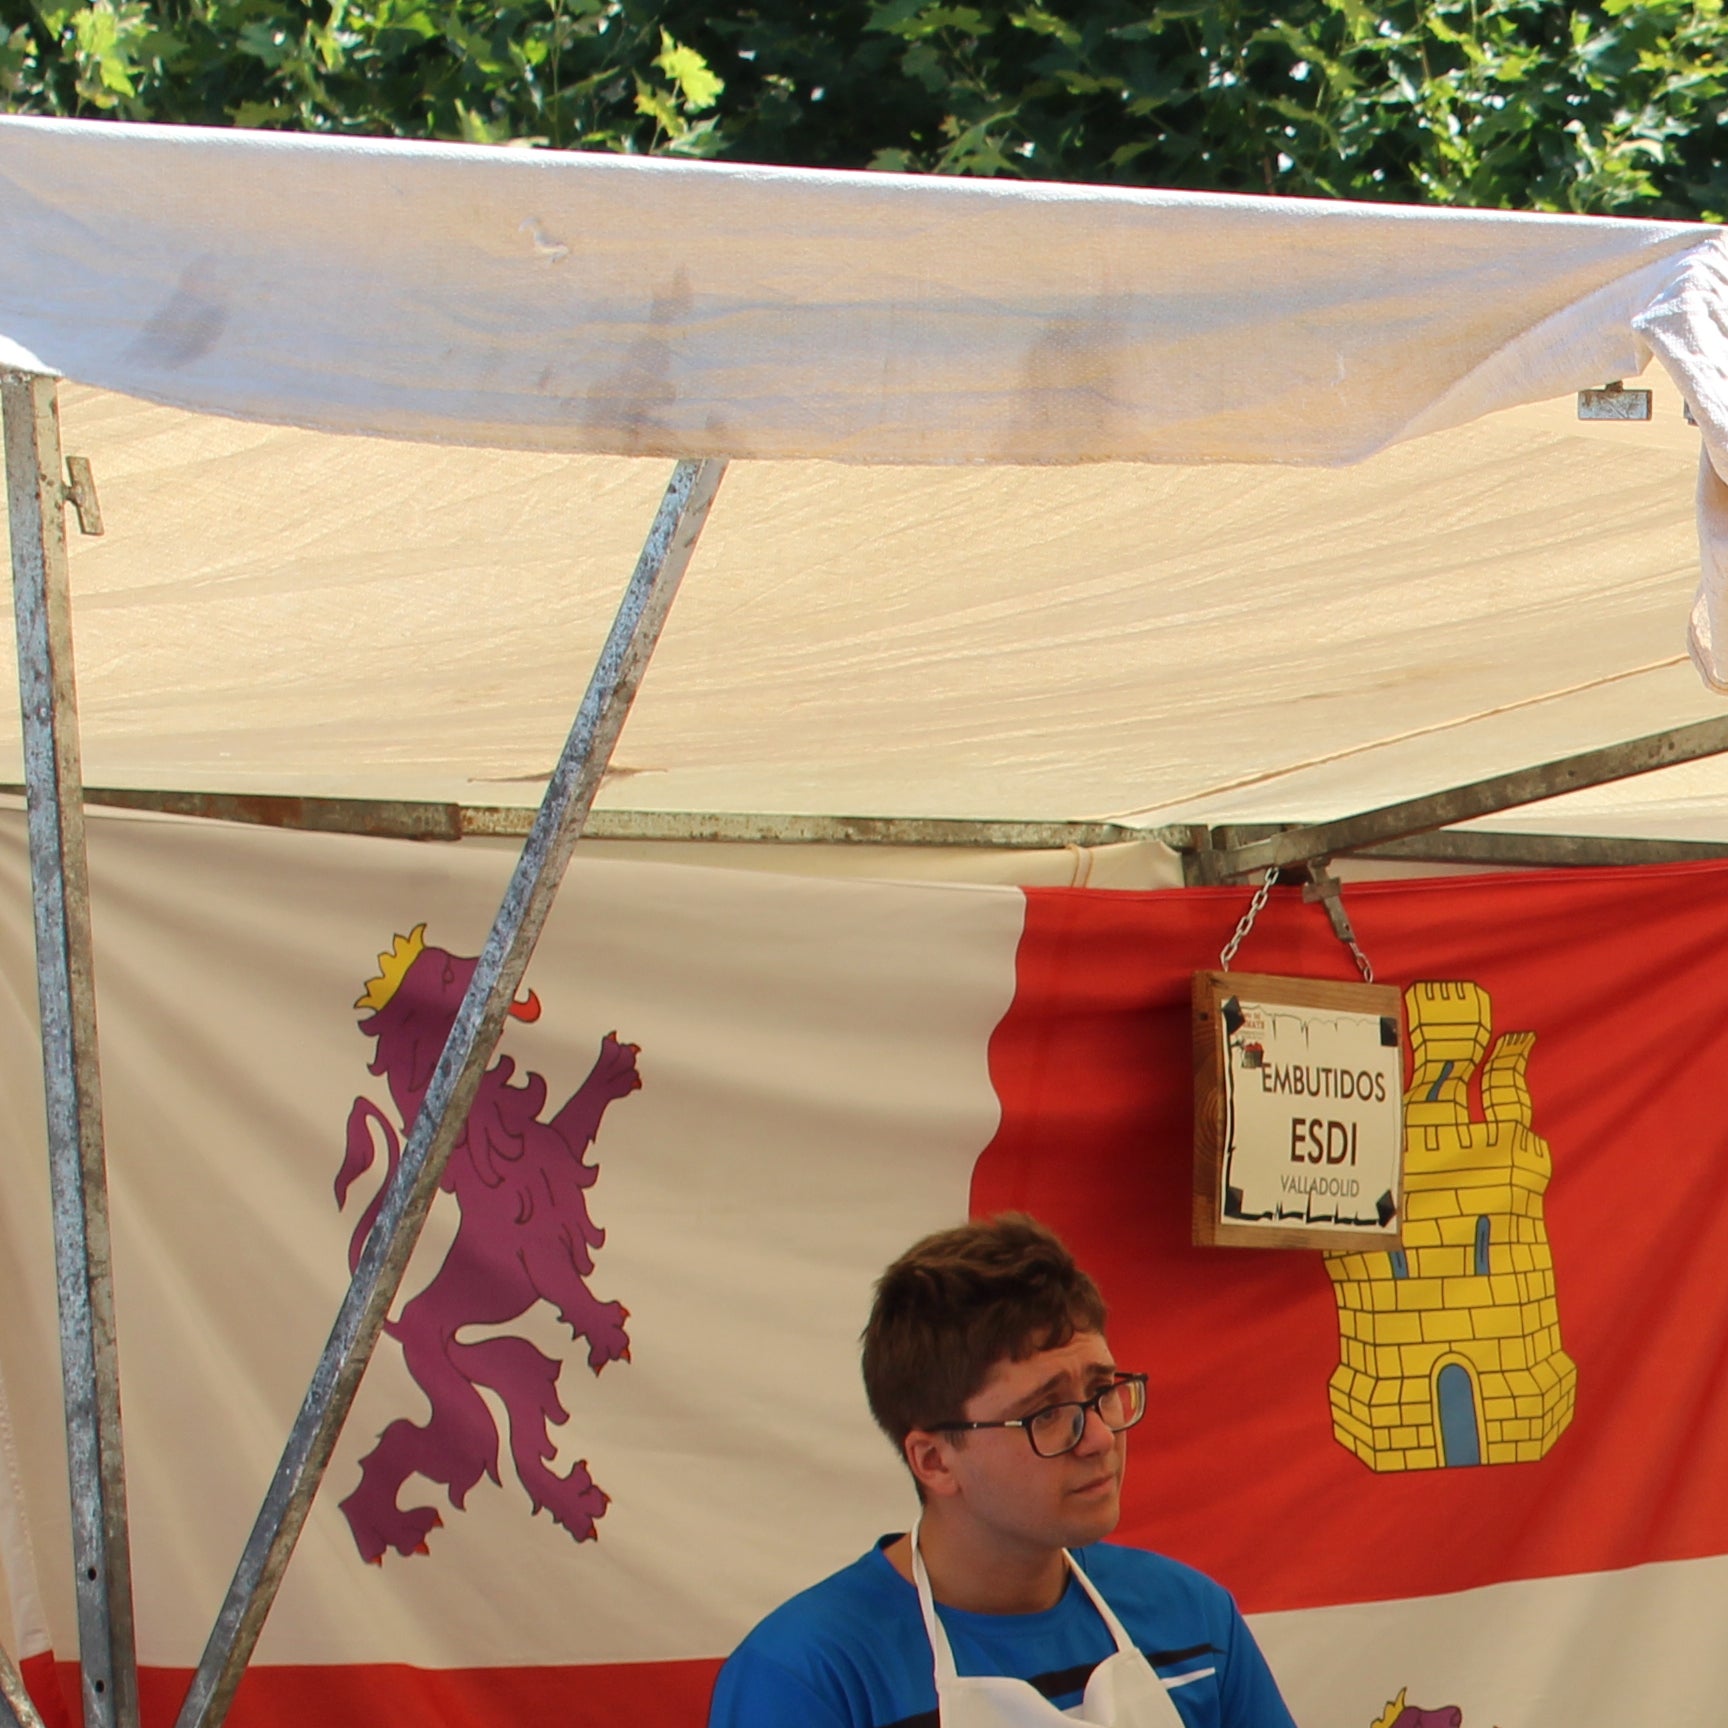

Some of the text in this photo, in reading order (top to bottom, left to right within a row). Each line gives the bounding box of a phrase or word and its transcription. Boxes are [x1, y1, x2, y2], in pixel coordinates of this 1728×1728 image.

[1261, 1063, 1386, 1103] EMBUTIDOS
[1290, 1117, 1357, 1167] ESDI
[1280, 1174, 1360, 1198] VALLADOLID
